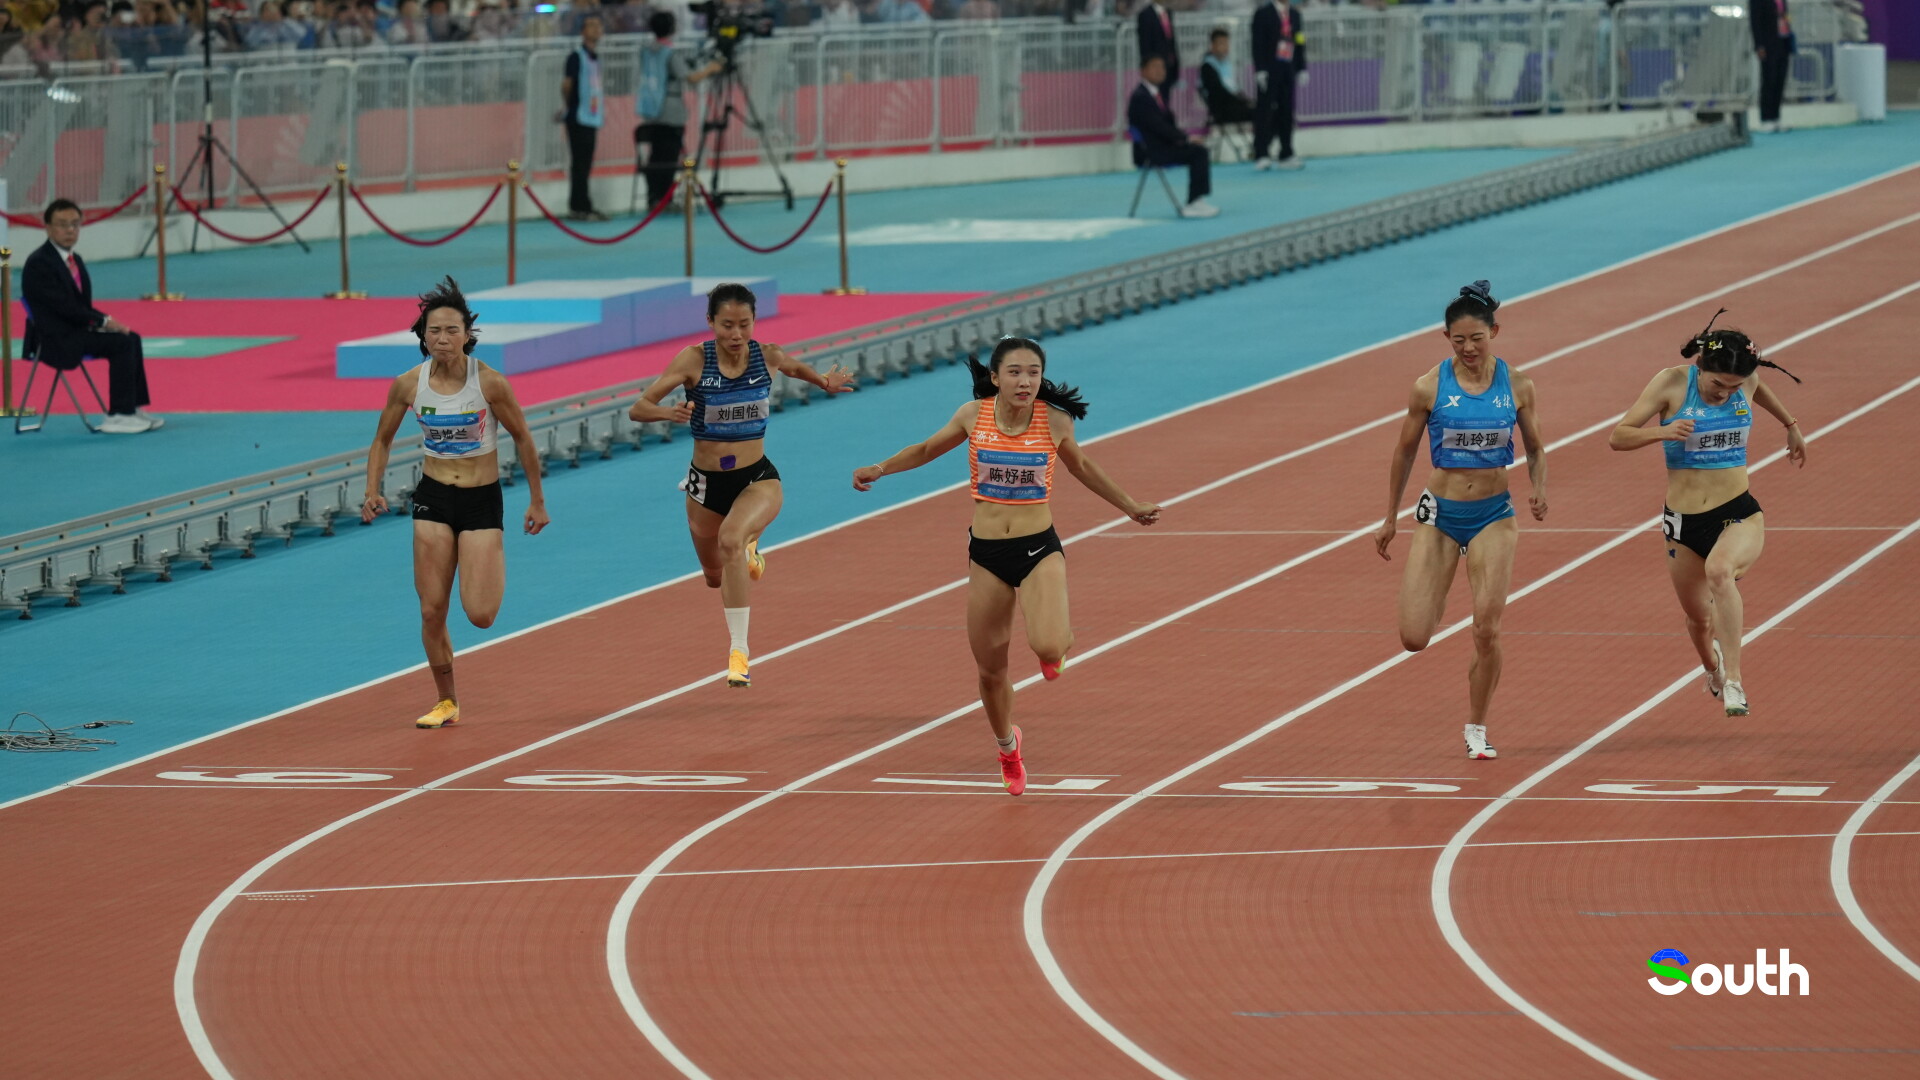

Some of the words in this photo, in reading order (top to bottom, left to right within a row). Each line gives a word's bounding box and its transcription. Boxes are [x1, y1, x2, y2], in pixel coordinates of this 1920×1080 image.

[702, 376, 721, 388] 四川
[717, 404, 759, 421] 刘国怡
[1683, 406, 1706, 417] 安徽
[1455, 432, 1499, 447] 孔玲瑶
[685, 468, 699, 496] 8
[989, 467, 1035, 484] 陈妤颉
[1417, 494, 1430, 522] 6
[1664, 511, 1674, 537] 5
[504, 774, 748, 786] 8
[1583, 783, 1829, 796] 5
